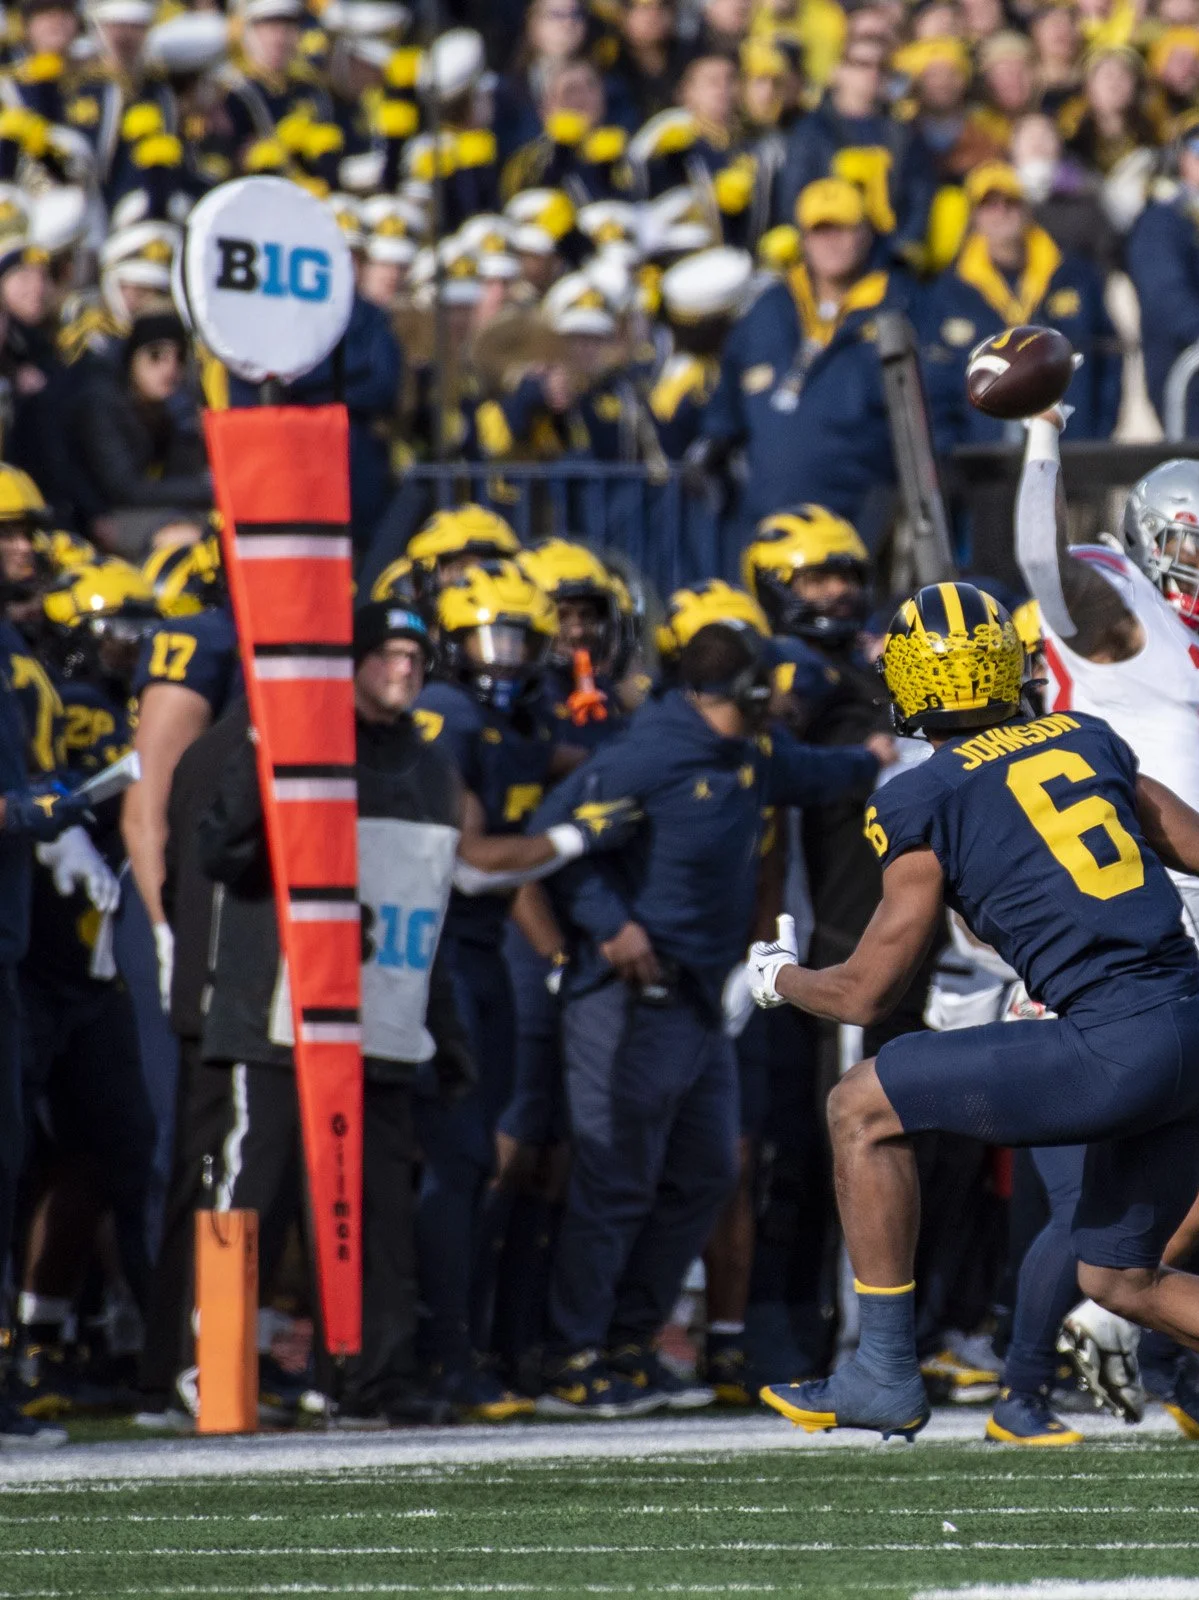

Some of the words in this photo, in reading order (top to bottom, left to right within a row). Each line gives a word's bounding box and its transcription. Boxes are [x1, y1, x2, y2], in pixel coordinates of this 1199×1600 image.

[149, 632, 197, 681] 17
[953, 713, 1081, 771] JOHNSON
[864, 806, 888, 857] 6
[1006, 748, 1144, 900] 6
